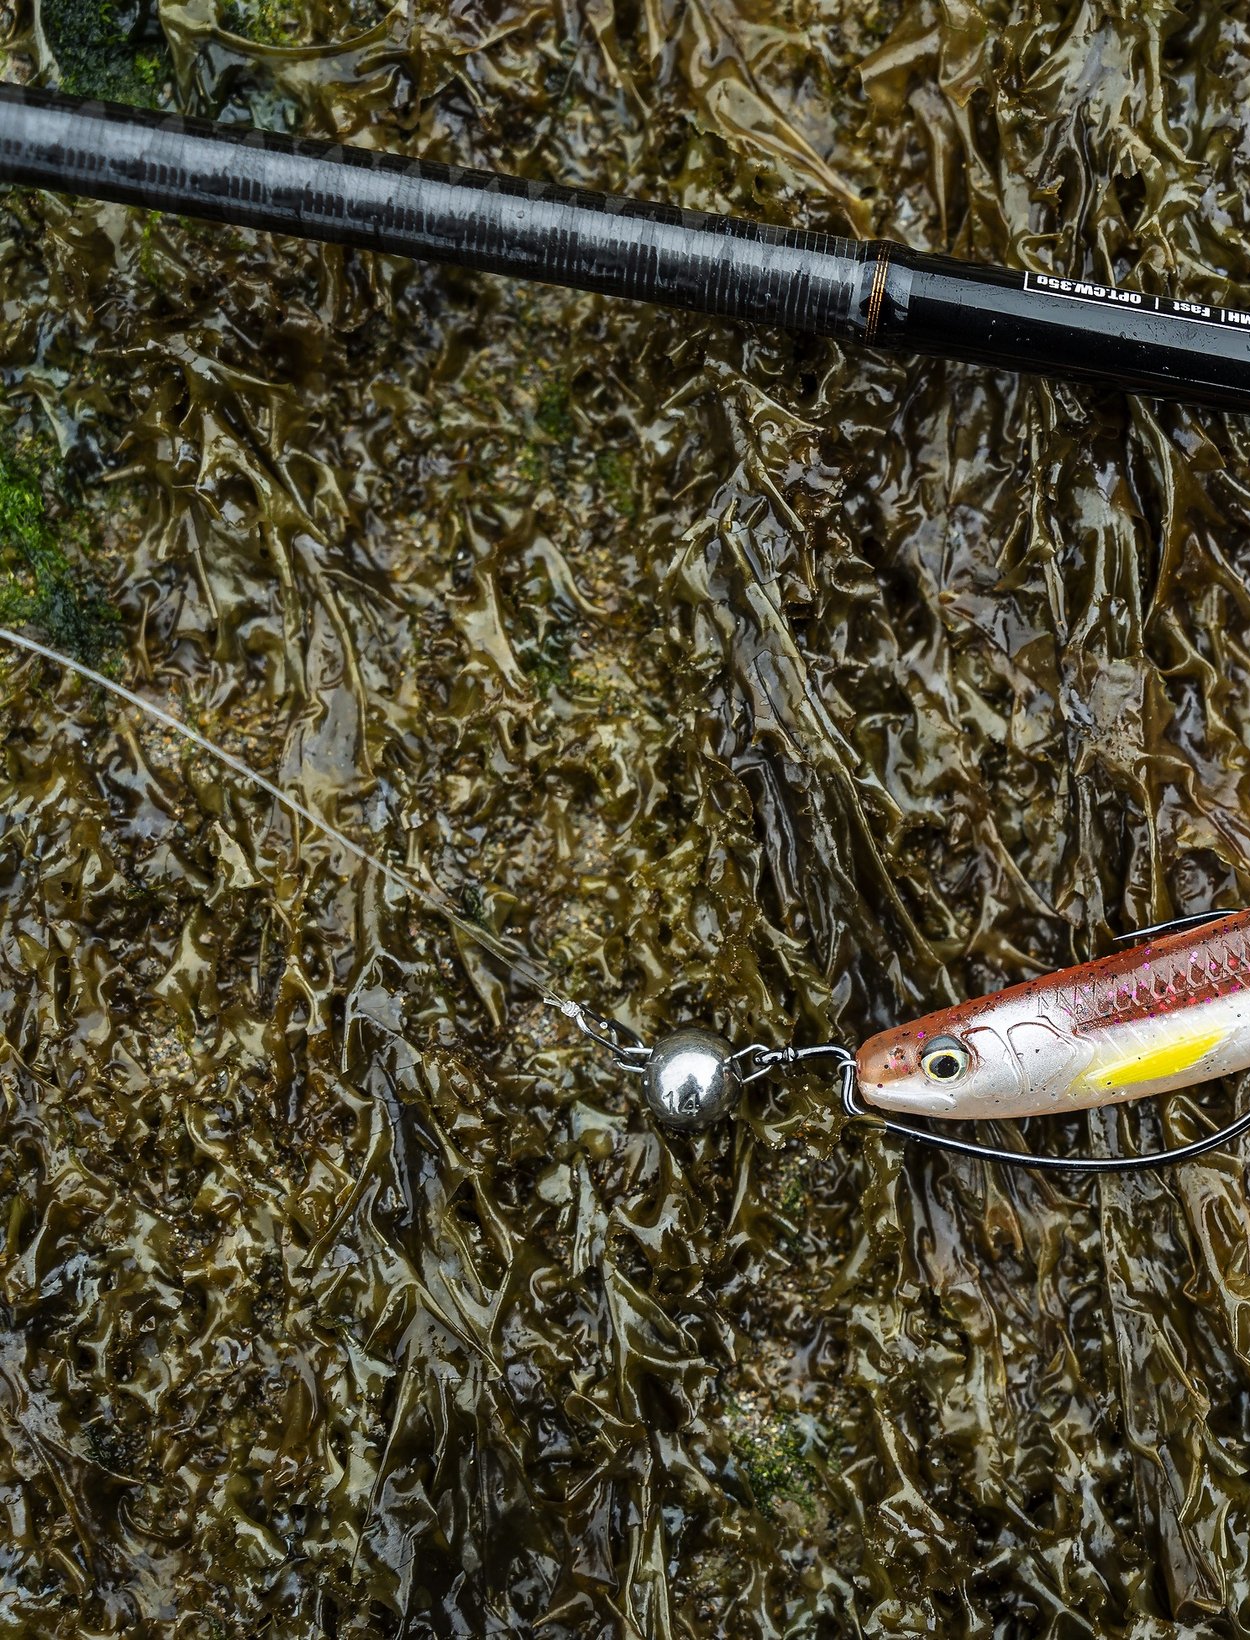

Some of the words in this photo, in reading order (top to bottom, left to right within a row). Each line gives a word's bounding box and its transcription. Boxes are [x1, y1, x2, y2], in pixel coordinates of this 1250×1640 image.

[1036, 275, 1142, 304] OPT.CW.35g
[1172, 301, 1211, 317] Fast
[662, 1090, 701, 1117] 14
